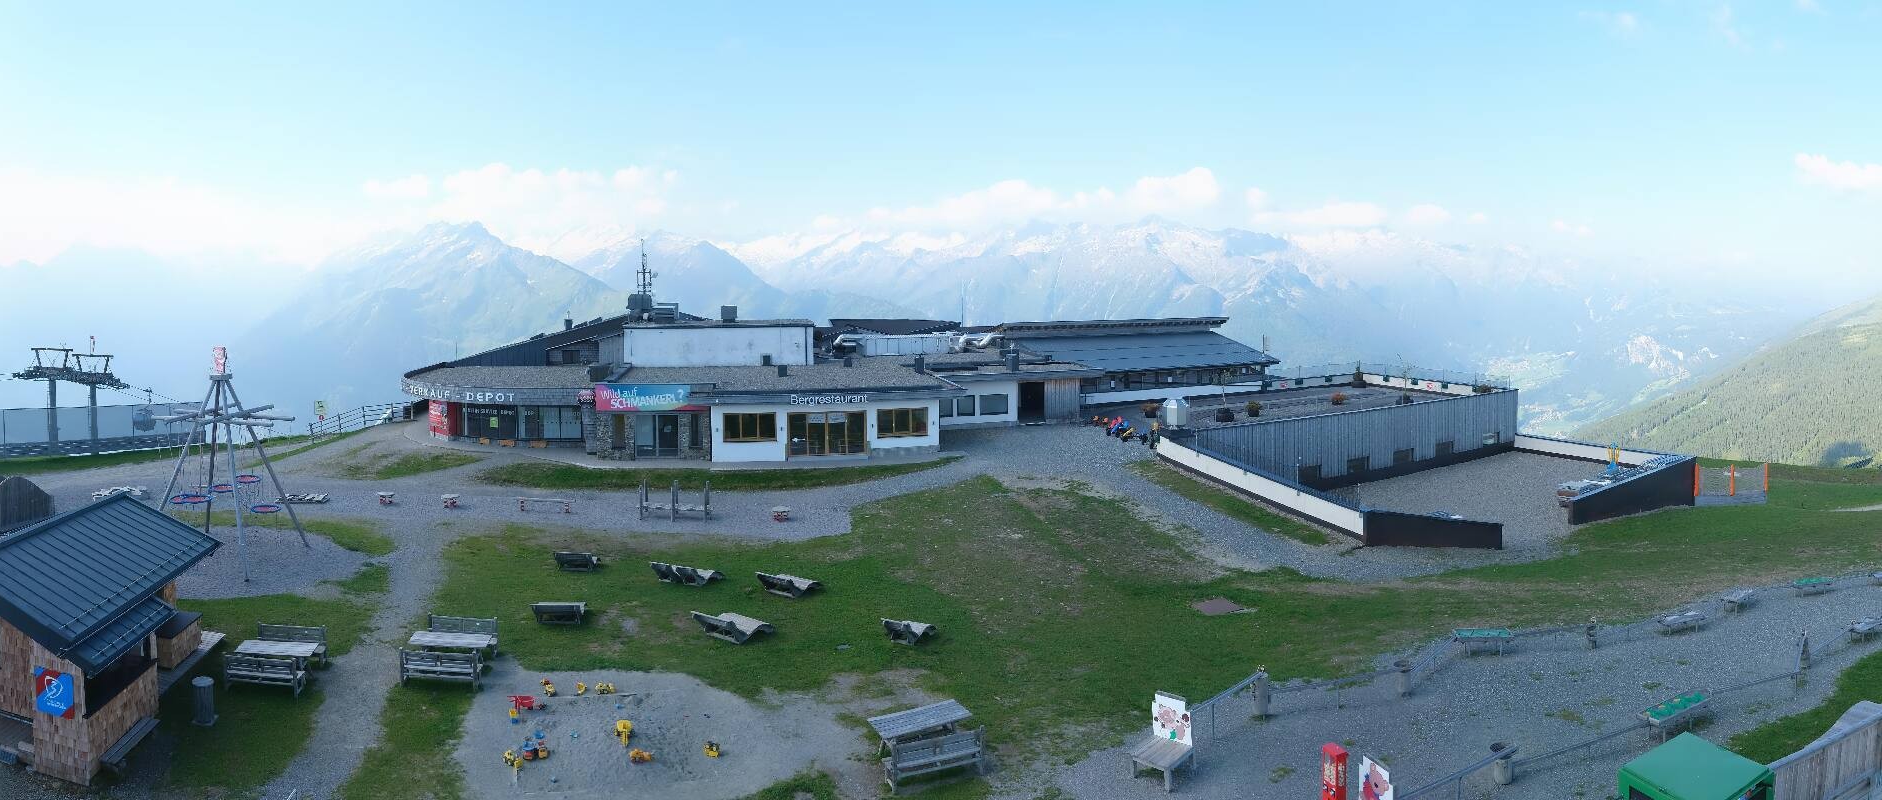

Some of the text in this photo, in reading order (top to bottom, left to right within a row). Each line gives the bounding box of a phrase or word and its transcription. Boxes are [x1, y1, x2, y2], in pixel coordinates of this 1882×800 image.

[466, 392, 515, 402] DEPOT
[601, 388, 621, 400] Wild
[622, 386, 638, 399] auf
[790, 394, 869, 407] Bergrestaurant
